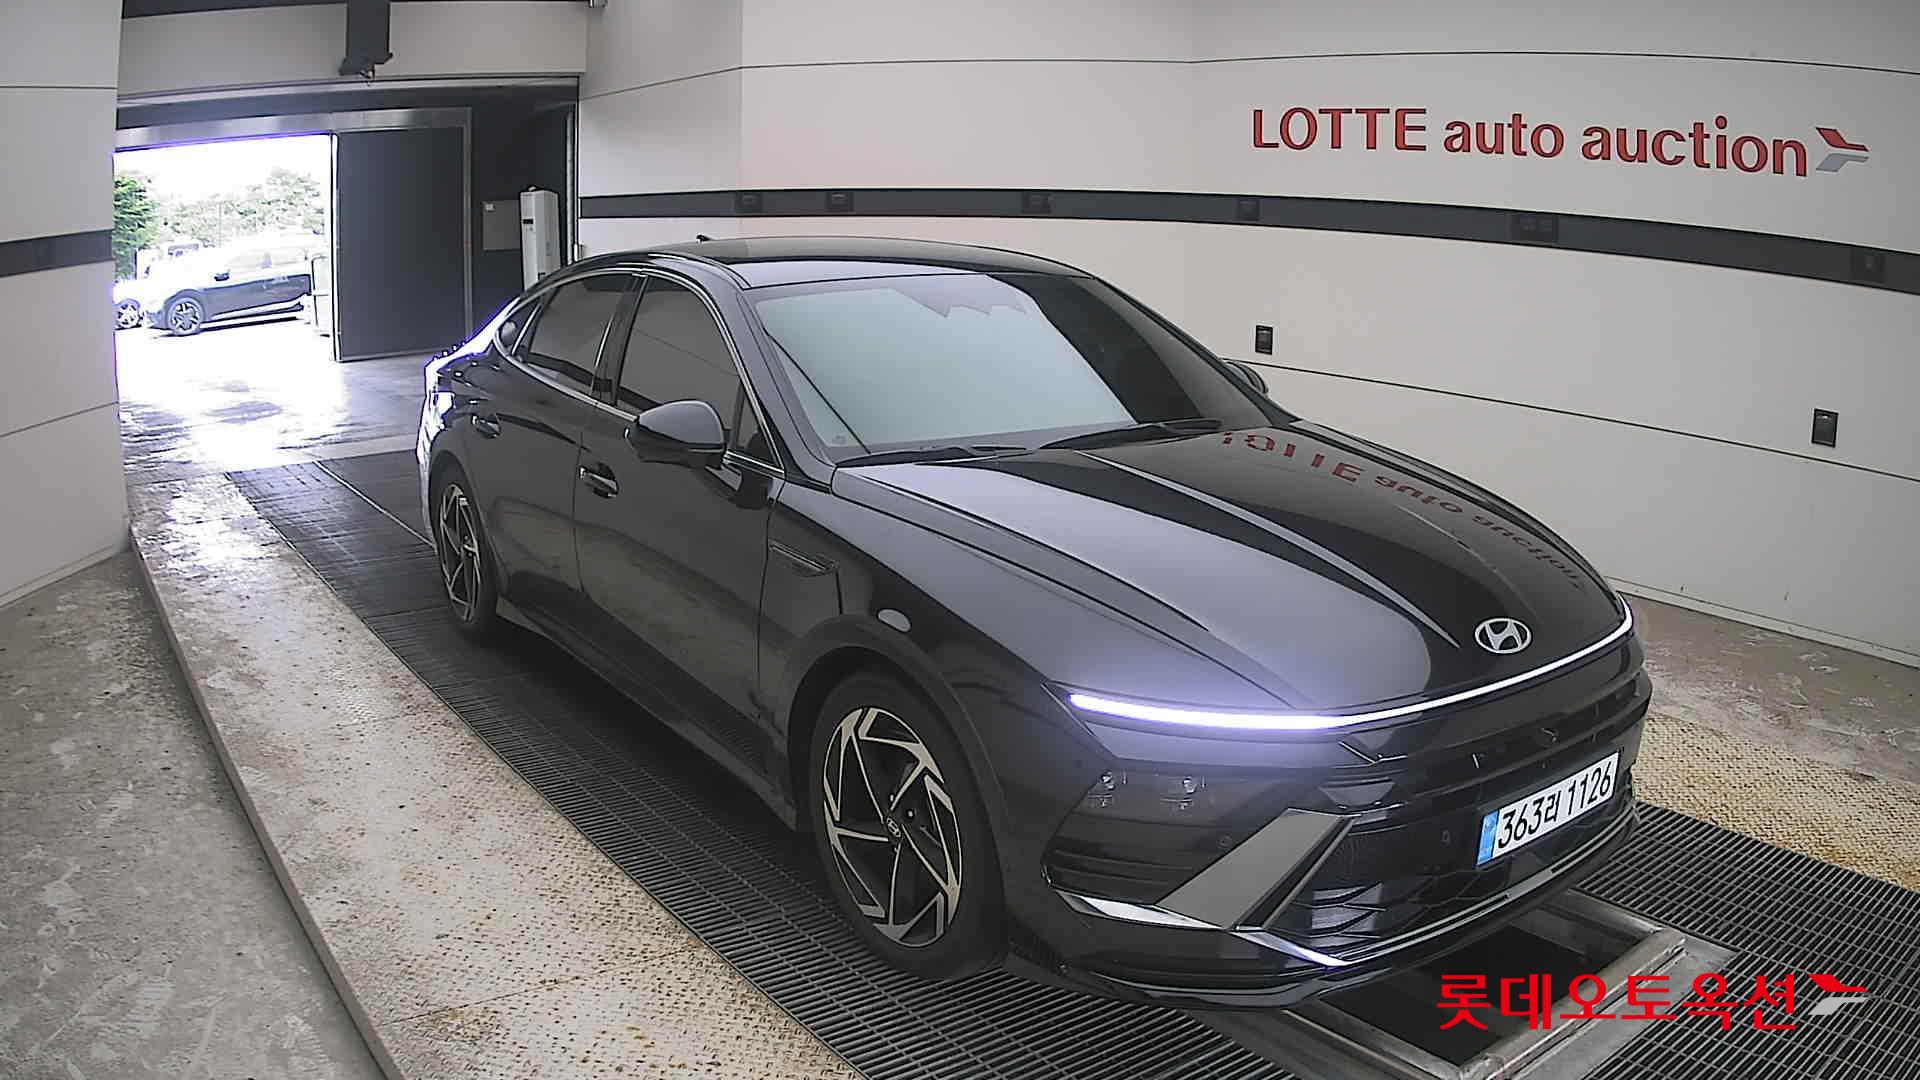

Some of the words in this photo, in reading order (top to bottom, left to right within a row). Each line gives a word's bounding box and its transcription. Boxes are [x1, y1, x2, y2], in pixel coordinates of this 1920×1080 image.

[1252, 107, 1427, 151] LOTTE
[1443, 113, 1565, 158] auto
[1581, 115, 1808, 177] auction
[1567, 761, 1612, 816] 1126
